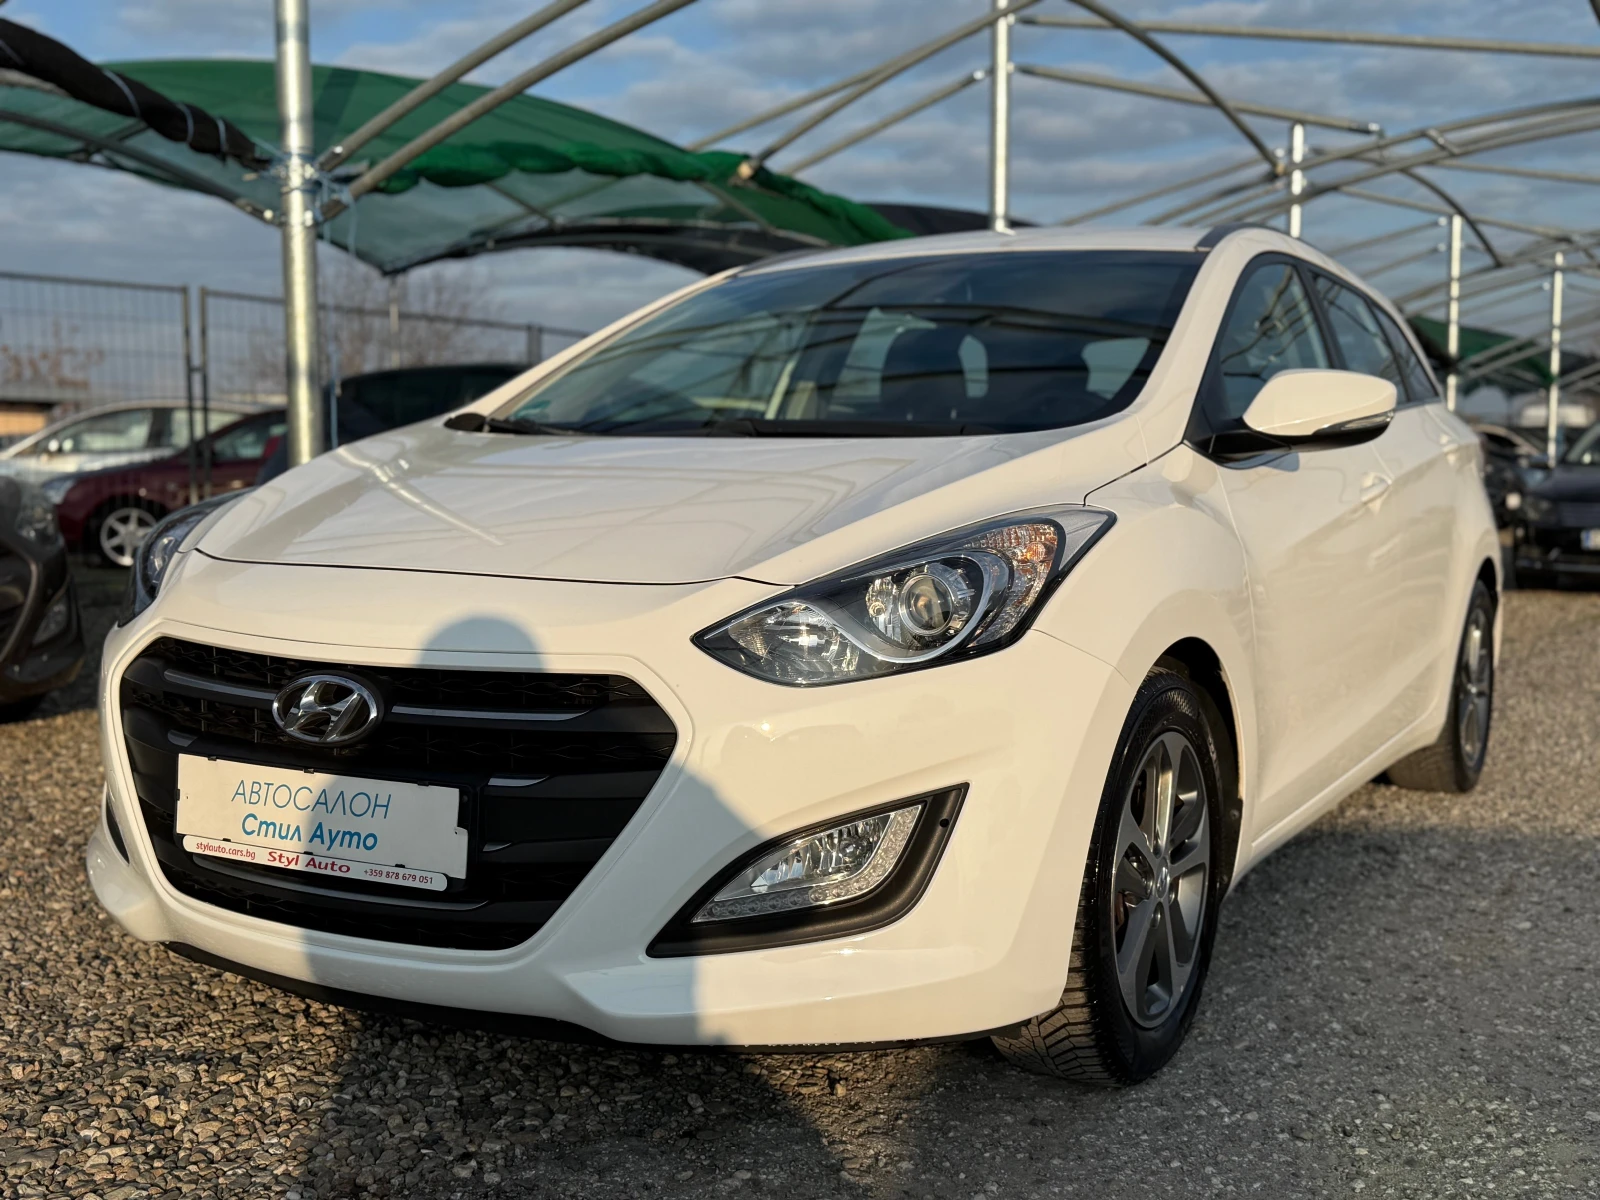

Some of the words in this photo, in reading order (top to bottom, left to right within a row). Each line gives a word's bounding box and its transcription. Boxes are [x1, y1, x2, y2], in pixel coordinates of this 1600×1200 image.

[231, 779, 392, 819] АВТОСАЛОН
[241, 813, 302, 842] Стил
[308, 821, 378, 851] Ауто
[195, 841, 256, 861] stylauto.cars.bg
[267, 851, 300, 867] Styl
[304, 856, 351, 874] Auto
[363, 868, 383, 878] +359
[385, 870, 400, 880] 878
[401, 873, 417, 882] 679
[418, 875, 433, 884] 051
